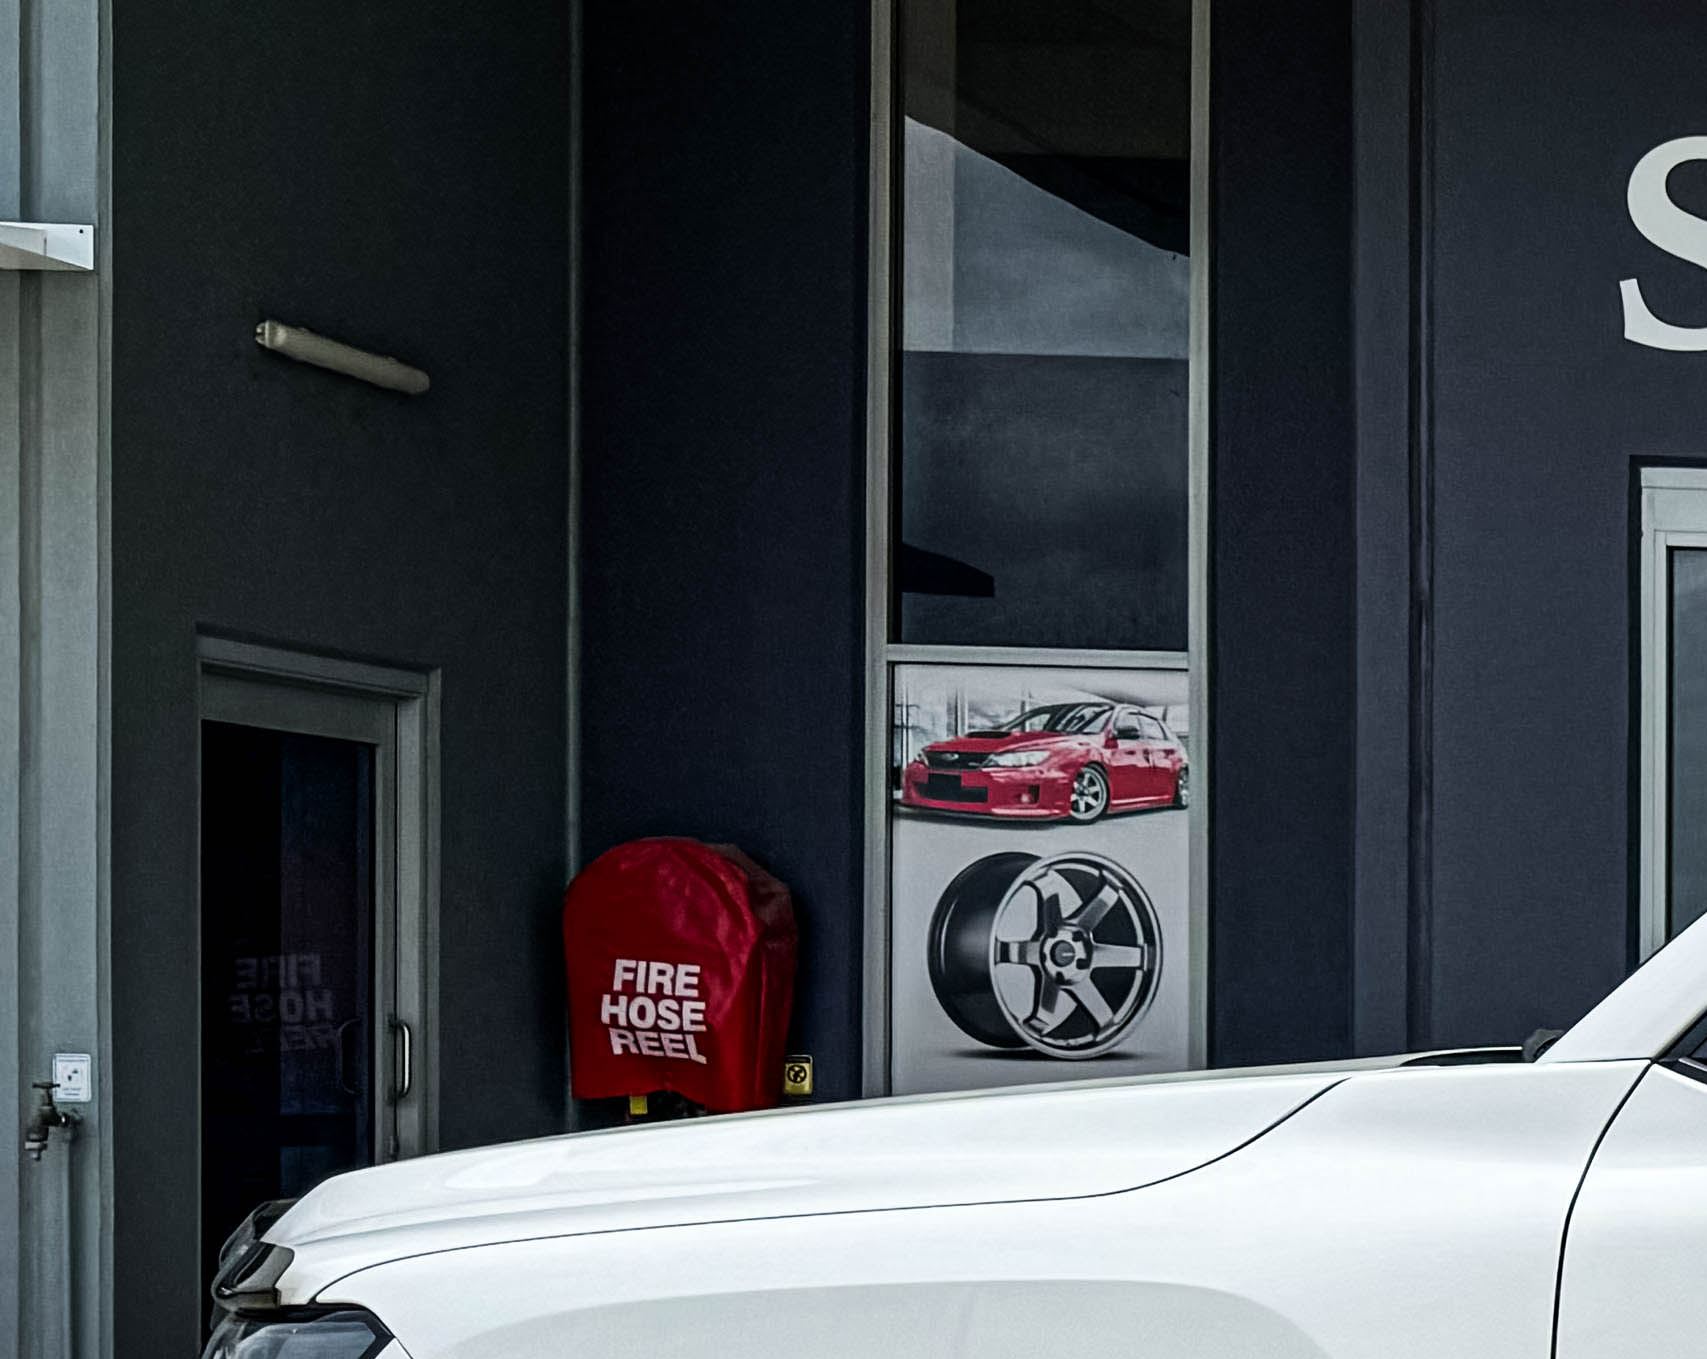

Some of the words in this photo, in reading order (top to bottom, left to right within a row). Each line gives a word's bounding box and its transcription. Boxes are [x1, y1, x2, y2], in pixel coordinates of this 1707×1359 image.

[612, 958, 701, 998] FIRE
[600, 993, 707, 1032] HOSE
[608, 1027, 707, 1065] REEL
